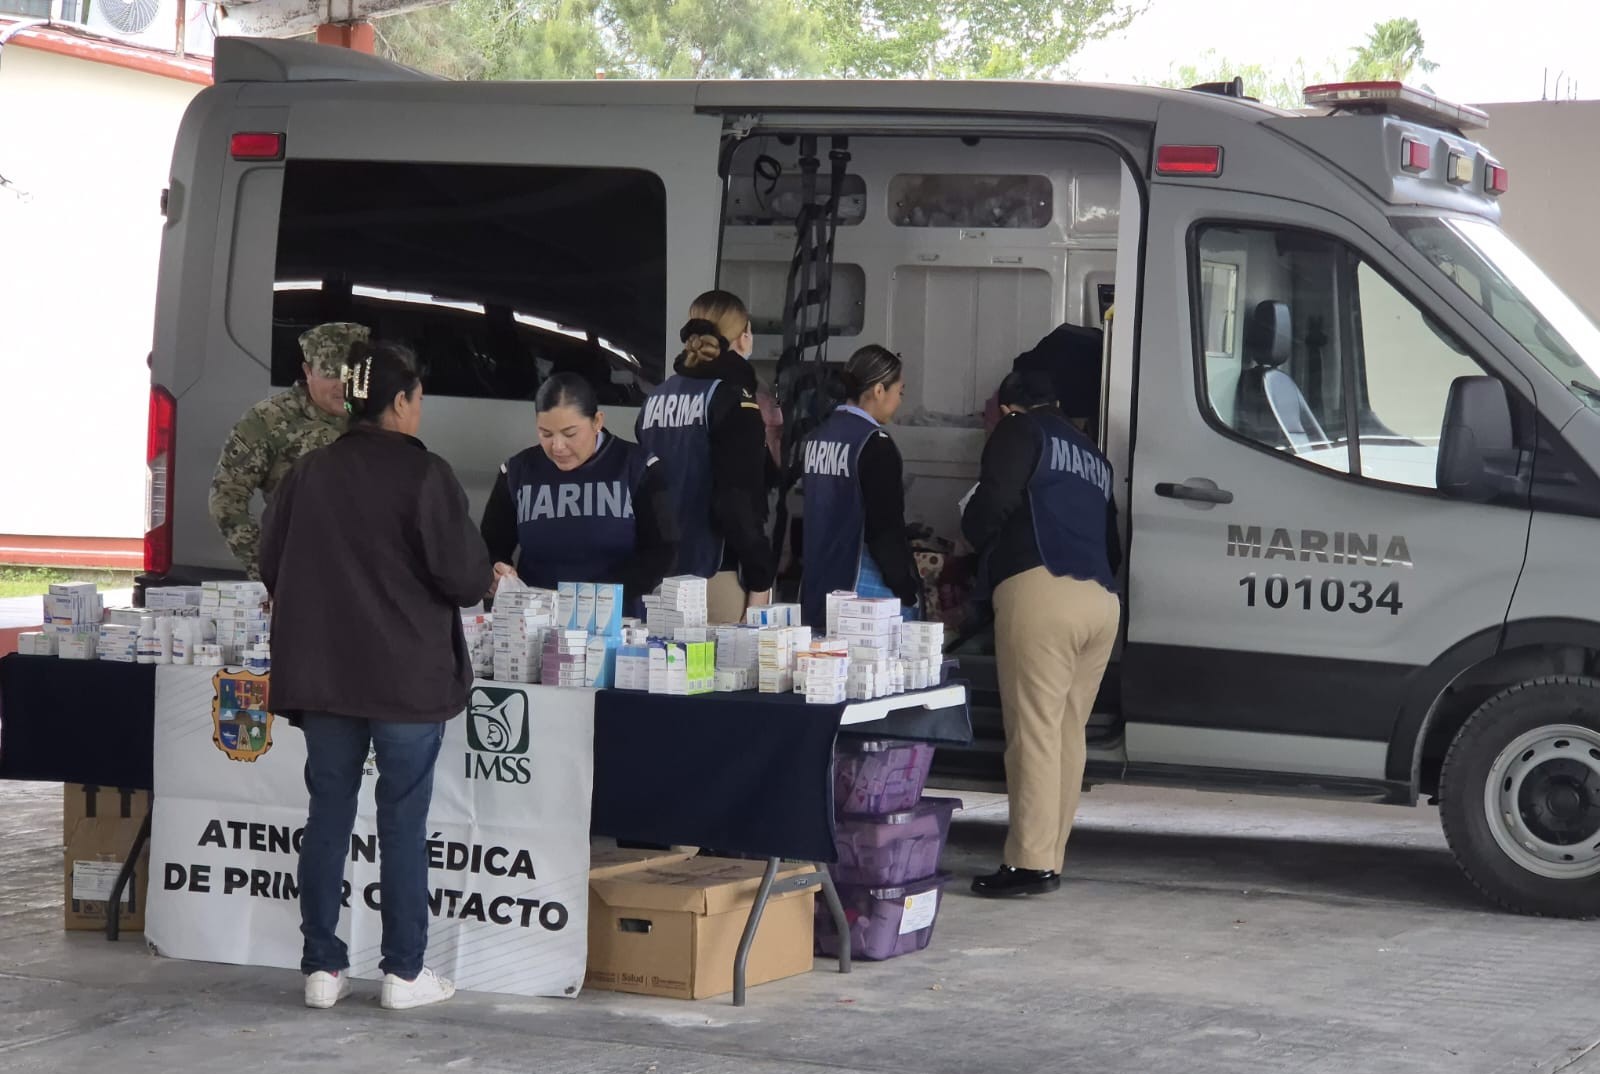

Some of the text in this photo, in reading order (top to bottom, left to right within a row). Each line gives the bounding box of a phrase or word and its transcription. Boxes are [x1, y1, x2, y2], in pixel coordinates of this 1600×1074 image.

[1051, 437, 1111, 502] MARIN
[1226, 524, 1414, 567] MARINA
[1239, 572, 1403, 615] 101034
[464, 752, 531, 784] IMSS
[426, 831, 536, 880] ÉDICA
[164, 862, 211, 893] DE
[364, 882, 568, 931] CNTACTO
